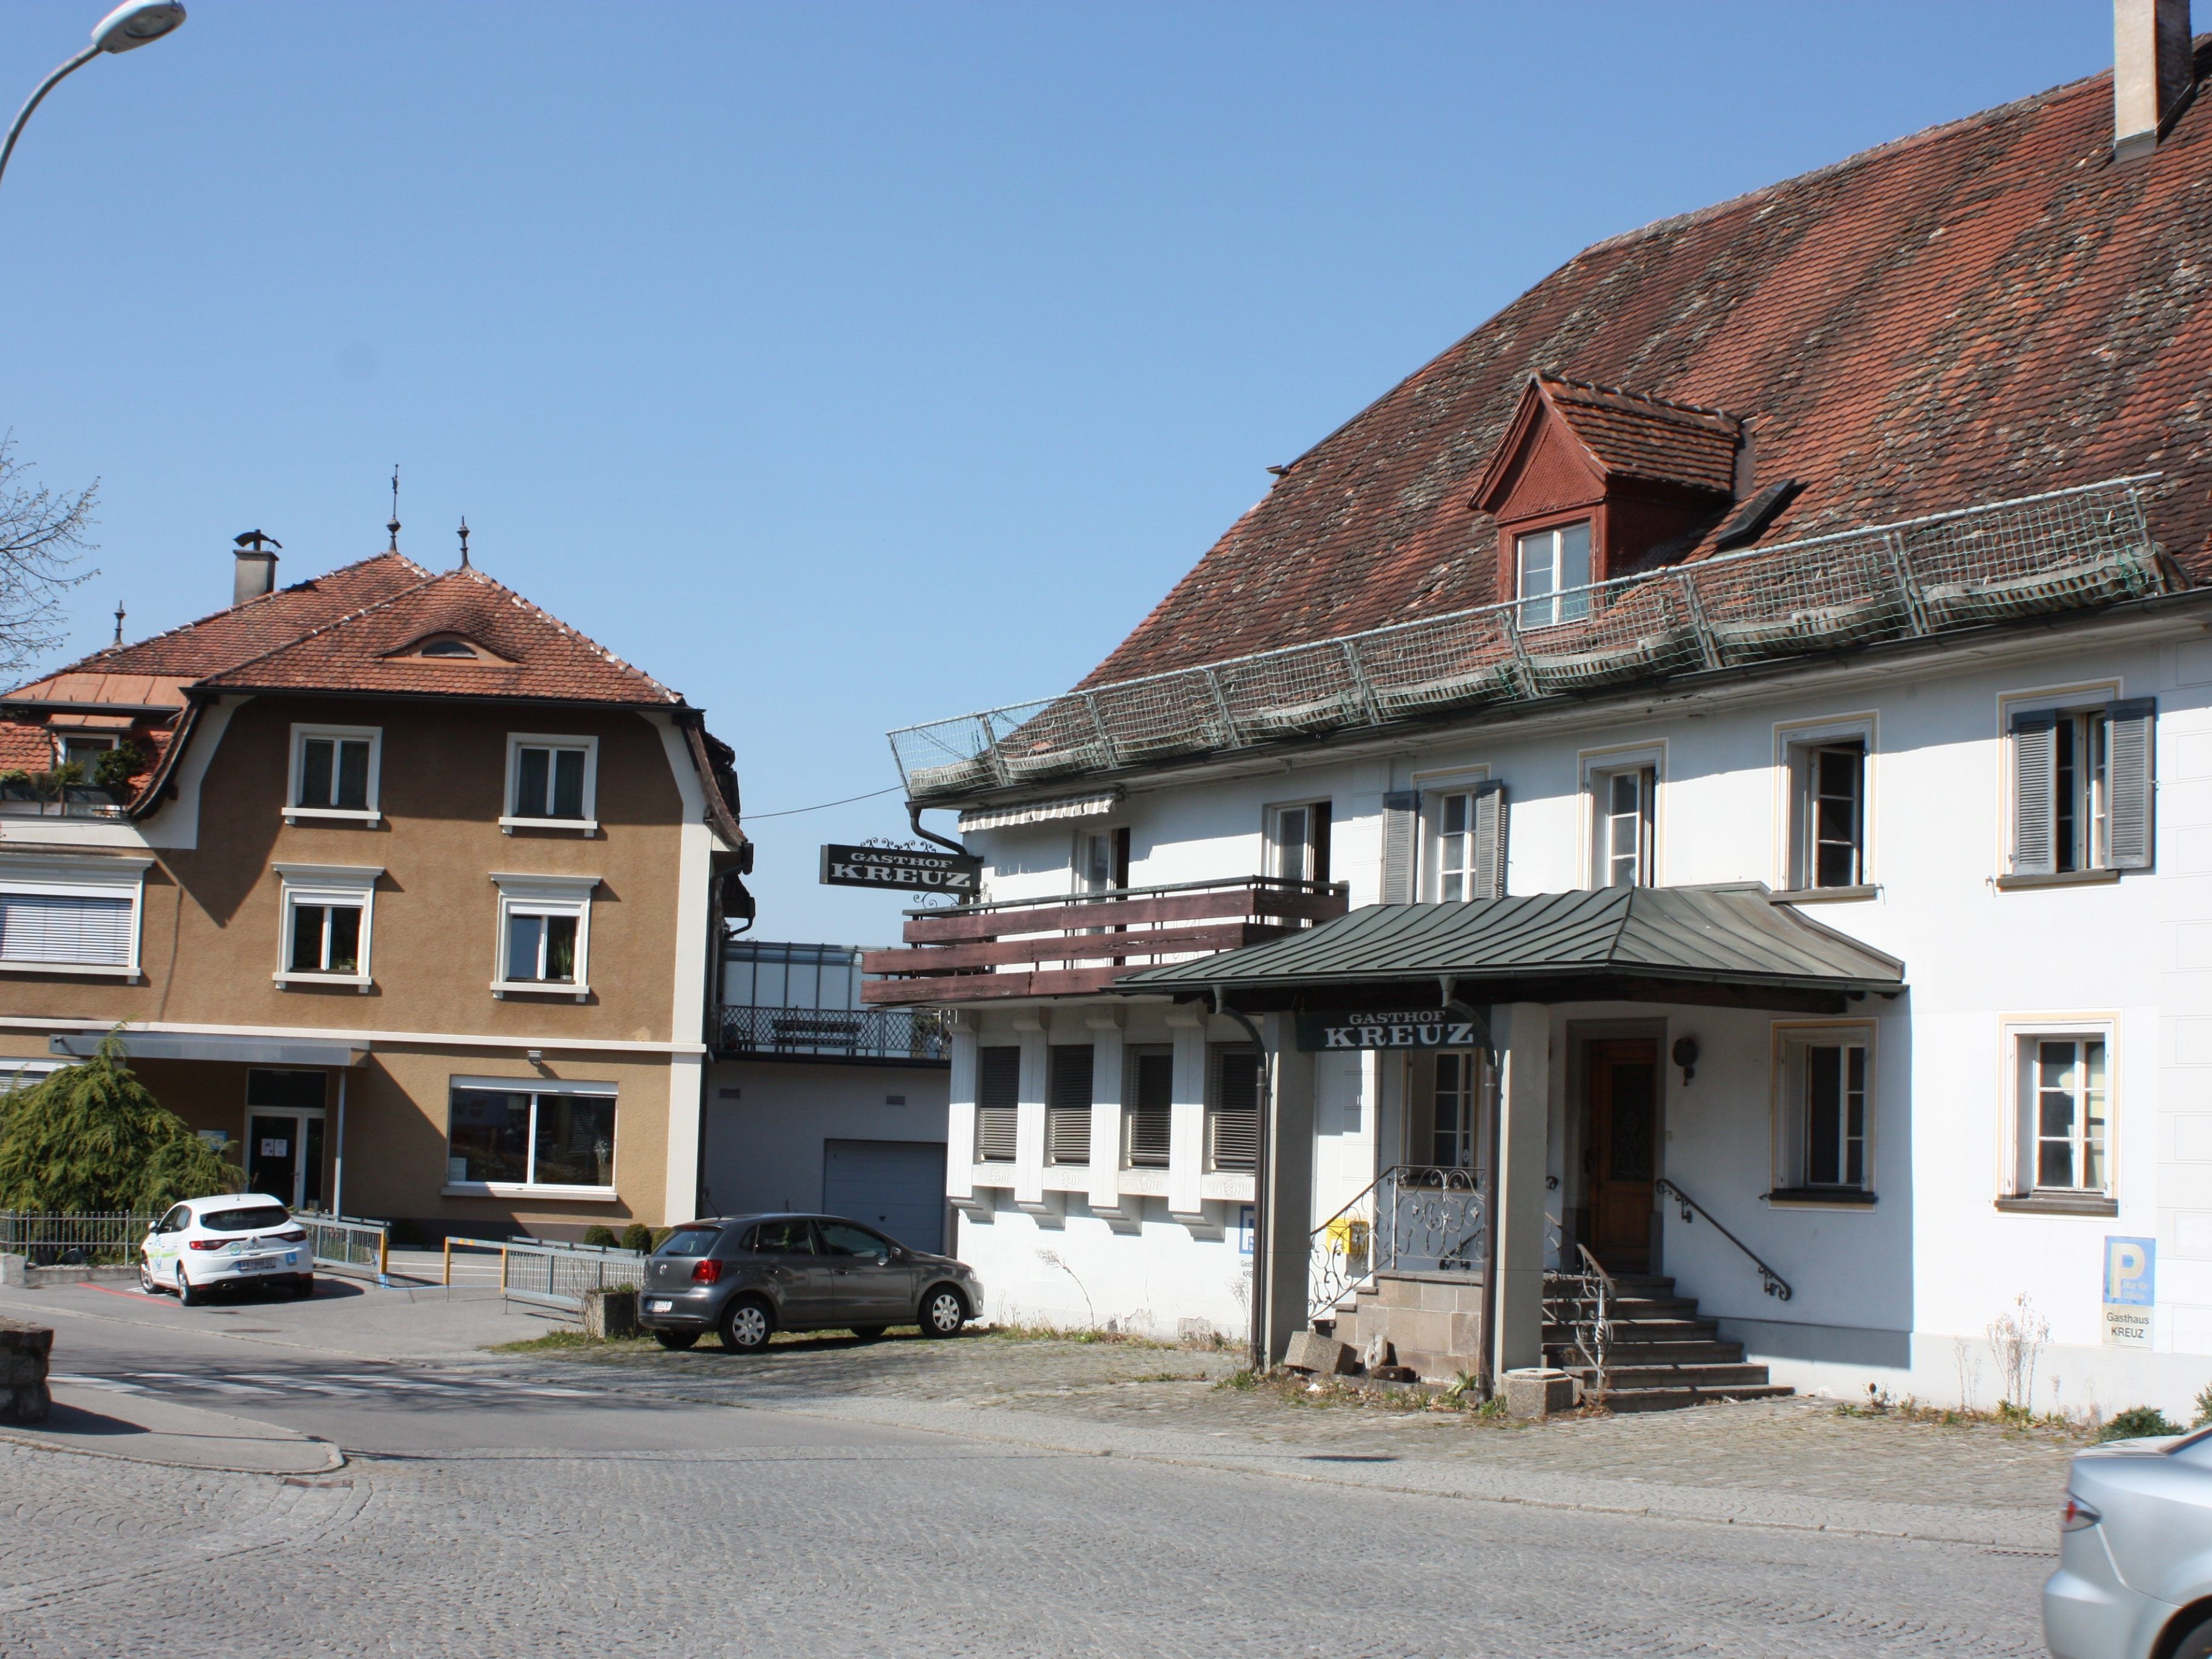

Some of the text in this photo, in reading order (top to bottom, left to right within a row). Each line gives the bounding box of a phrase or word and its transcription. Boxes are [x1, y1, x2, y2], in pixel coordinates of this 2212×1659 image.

[851, 853, 952, 868] GASTHOF
[831, 863, 970, 888] KREUZ
[1349, 1011, 1445, 1025] GASTHOF
[1324, 1023, 1473, 1047] KREUZ
[289, 1254, 295, 1262] L
[2109, 1243, 2145, 1298] P
[2106, 1312, 2149, 1325] Gasthaus
[2111, 1326, 2145, 1338] KREUZ
